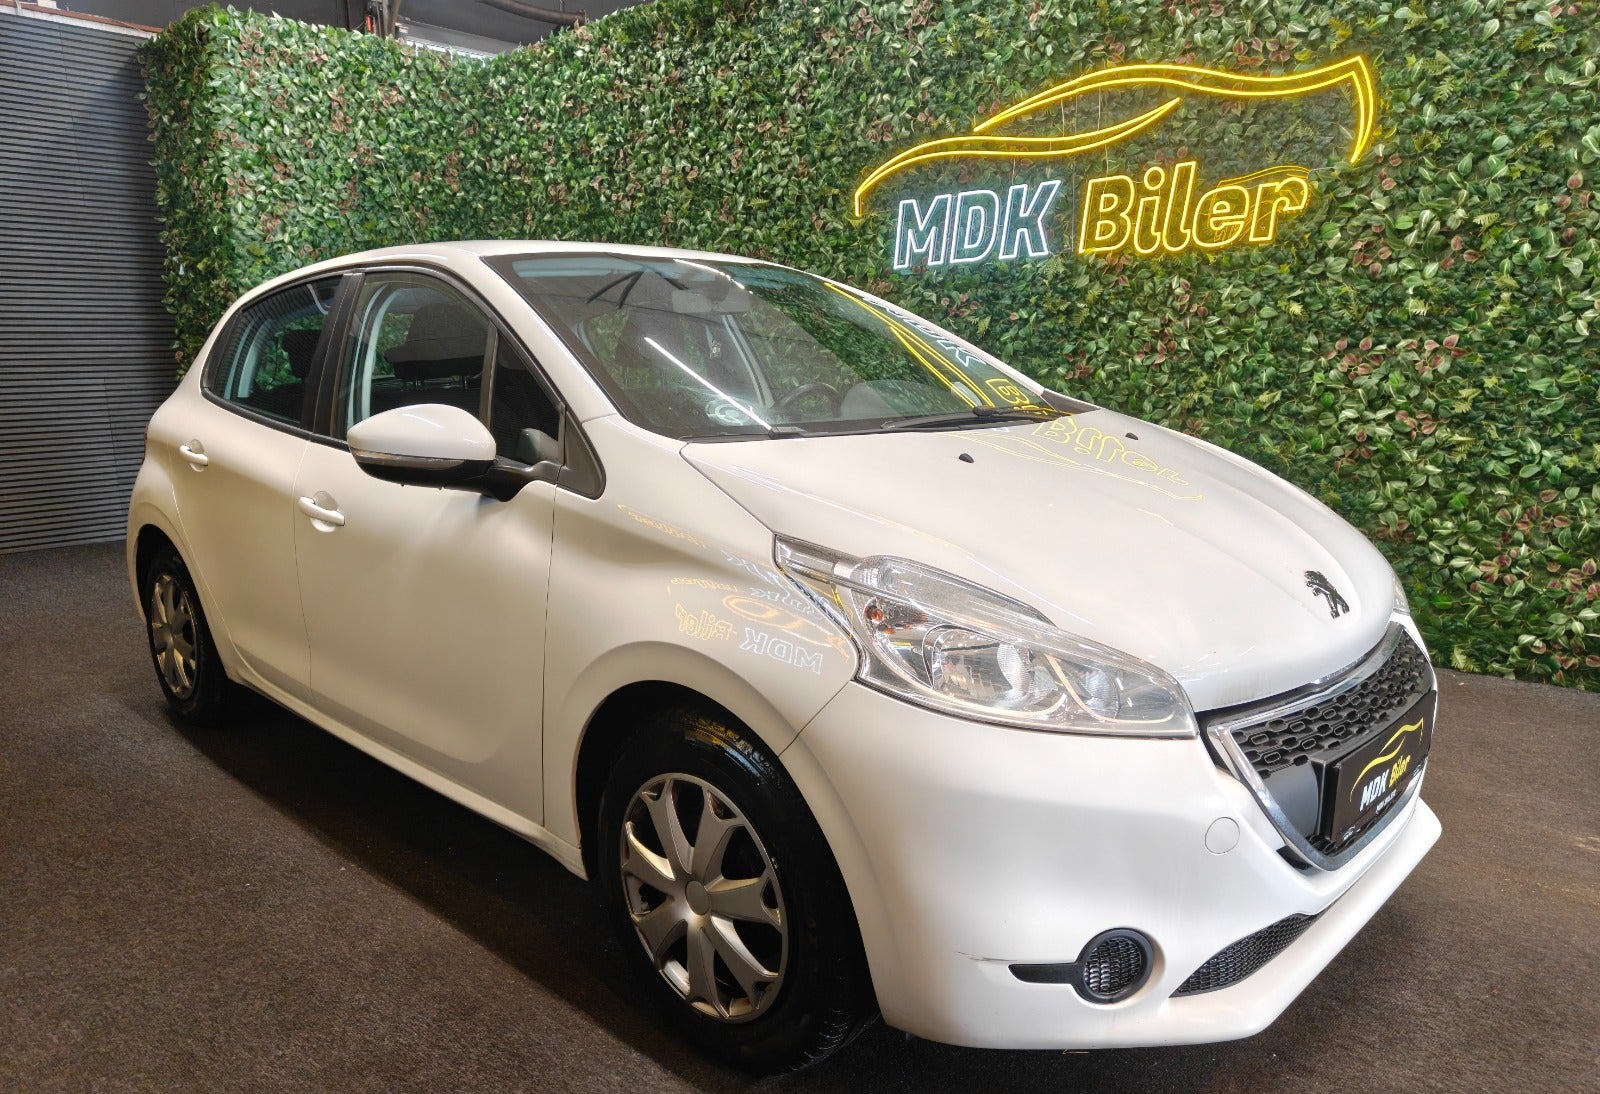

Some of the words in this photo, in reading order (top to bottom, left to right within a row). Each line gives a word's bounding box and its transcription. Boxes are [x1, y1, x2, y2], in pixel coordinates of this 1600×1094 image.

[893, 179, 1063, 270] MDK
[1078, 160, 1310, 255] Biler
[1359, 768, 1390, 812] MDK
[1388, 754, 1411, 788] Biler
